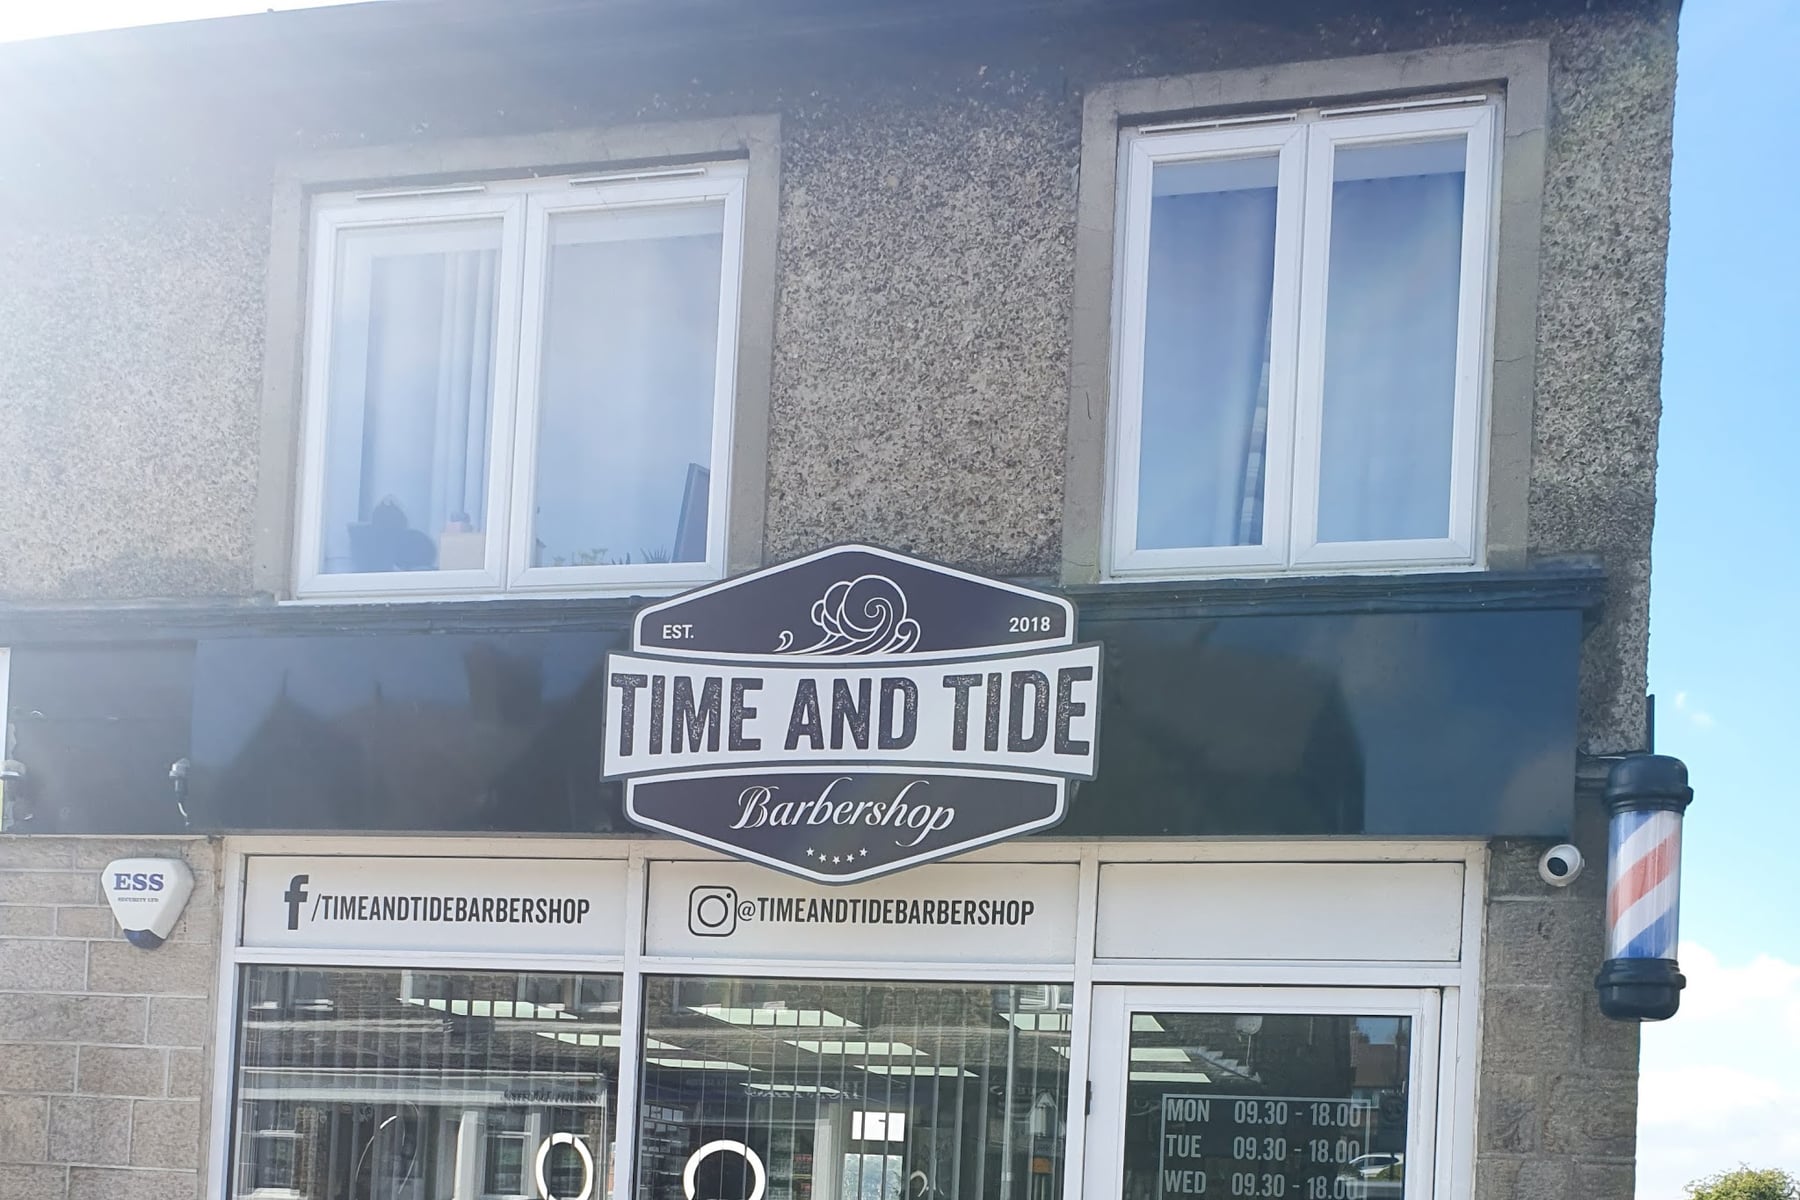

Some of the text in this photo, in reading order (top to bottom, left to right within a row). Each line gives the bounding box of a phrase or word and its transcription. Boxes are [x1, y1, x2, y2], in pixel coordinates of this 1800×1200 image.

[662, 623, 695, 640] EST.
[1008, 616, 1051, 633] 2018
[611, 665, 1094, 757] TIME AND TIDE
[730, 776, 956, 847] Barbershop
[113, 873, 165, 891] ESS
[737, 897, 1035, 926] @TIMEANDTIDEBARBERSHOP
[1167, 1099, 1210, 1122] MON
[1234, 1101, 1288, 1125] 09.30
[1310, 1103, 1361, 1127] 18.00
[1165, 1134, 1202, 1158] TUE
[1233, 1136, 1287, 1161] 09.30
[1309, 1139, 1360, 1163] 18.00
[1164, 1170, 1206, 1194] WED
[1232, 1172, 1285, 1197] 09.30
[1307, 1176, 1358, 1200] 18.00
